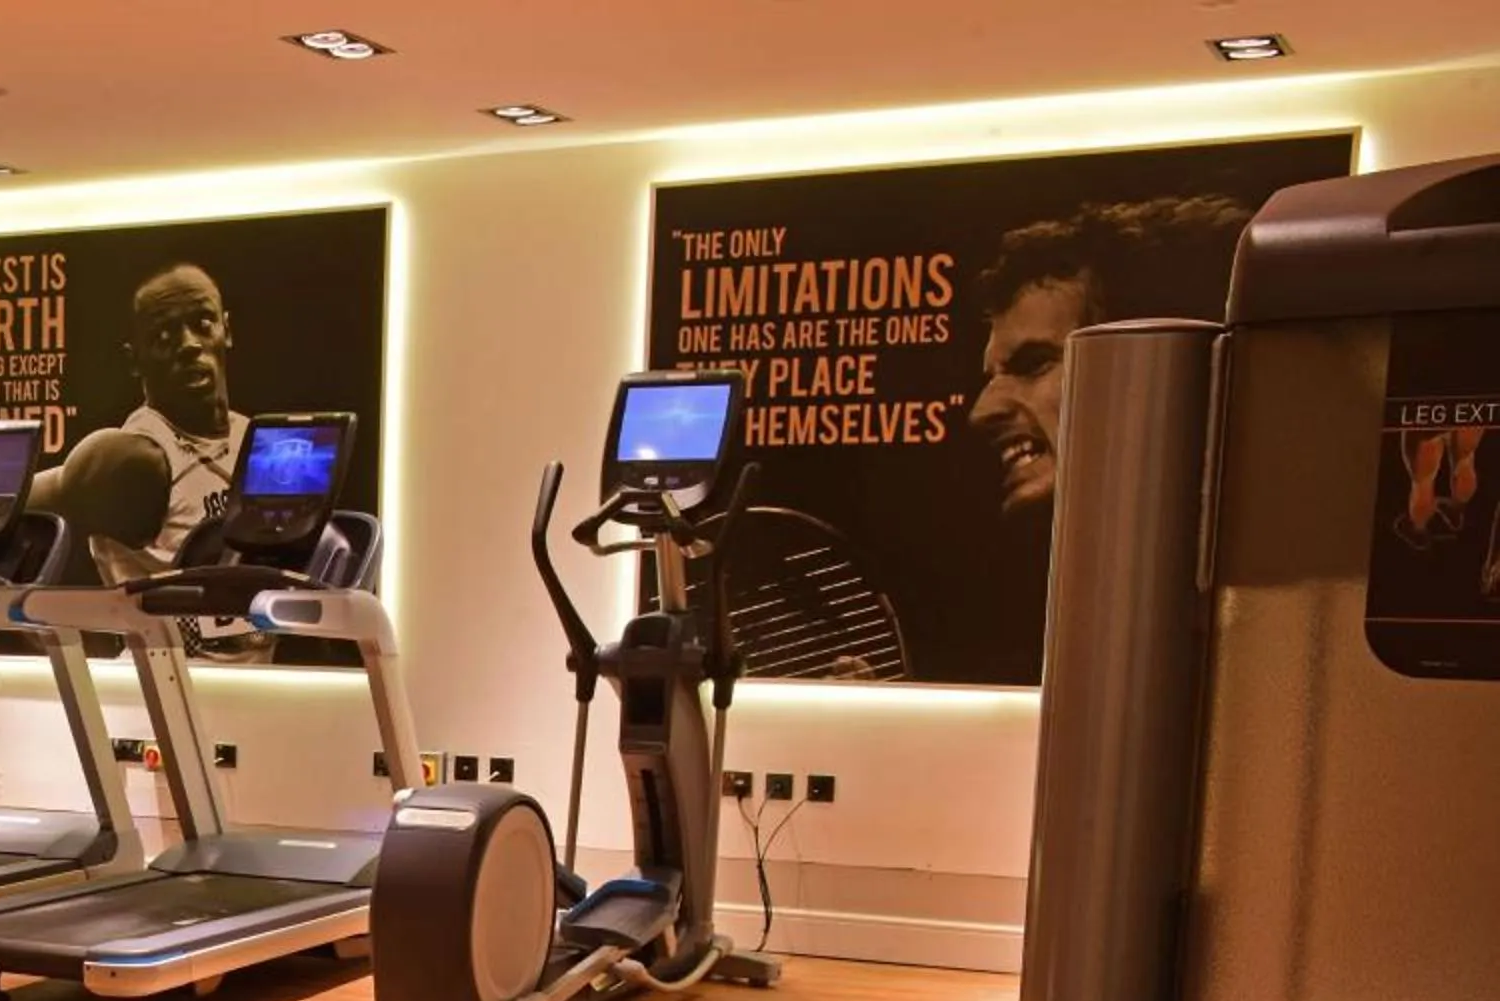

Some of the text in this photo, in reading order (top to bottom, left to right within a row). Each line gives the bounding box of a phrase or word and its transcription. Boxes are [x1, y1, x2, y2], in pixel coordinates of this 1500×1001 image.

[672, 227, 787, 261] "THE ONLY
[41, 253, 67, 291] IS
[680, 253, 954, 319] LIMITATIONS
[678, 313, 950, 353] ONE HAS ARE THE ONES
[9, 353, 67, 377] EXCEPT
[769, 354, 877, 398] PLACE
[4, 380, 40, 402] THAT
[45, 379, 60, 400] IS
[745, 394, 964, 446] HEMSELVES"
[1401, 404, 1447, 425] LEG
